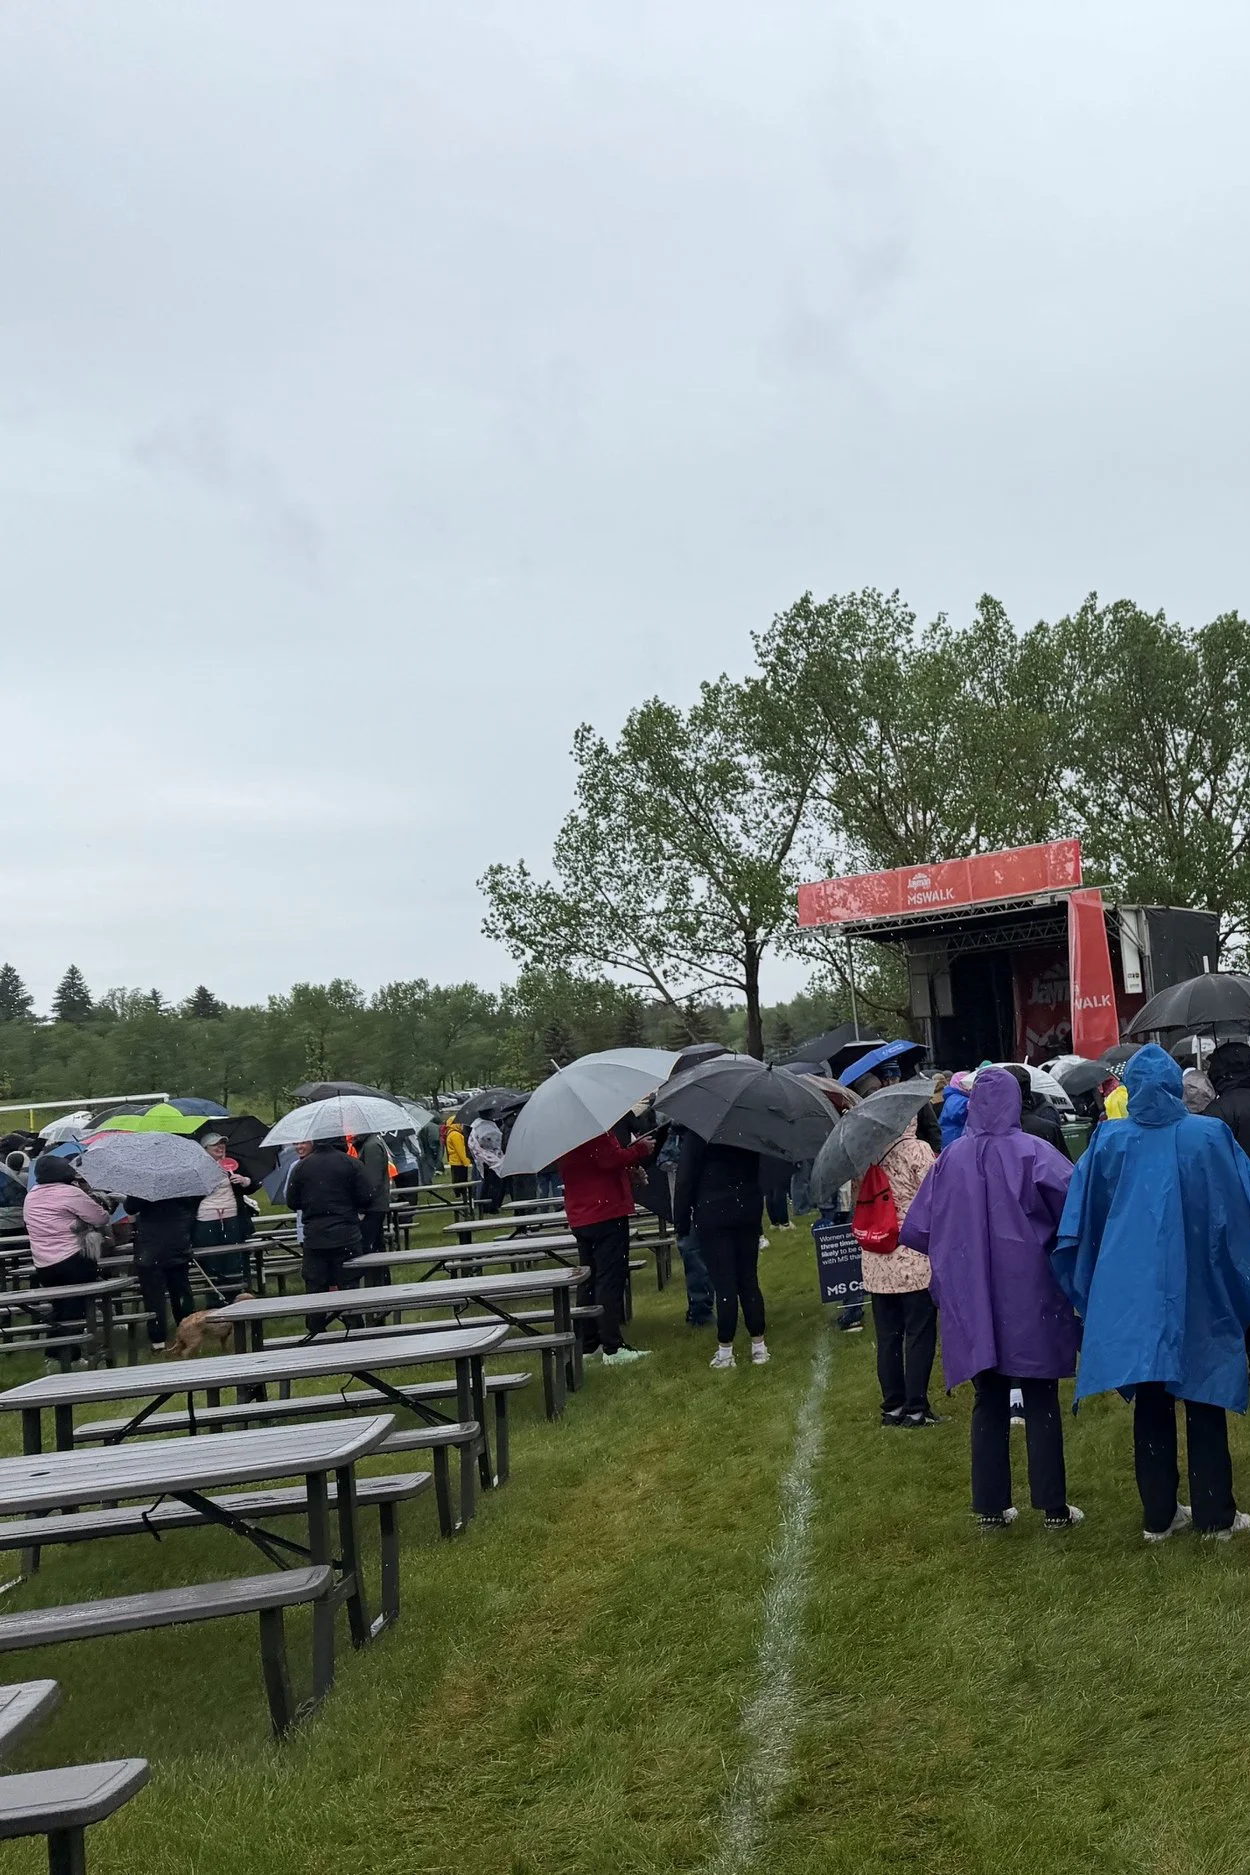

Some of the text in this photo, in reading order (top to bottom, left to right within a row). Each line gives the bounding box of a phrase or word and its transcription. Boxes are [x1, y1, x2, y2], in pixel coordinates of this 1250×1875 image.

[907, 887, 955, 905] MSWALK
[820, 1234, 844, 1242] Women
[821, 1249, 839, 1258] likely
[827, 1280, 864, 1296] MS Ca
